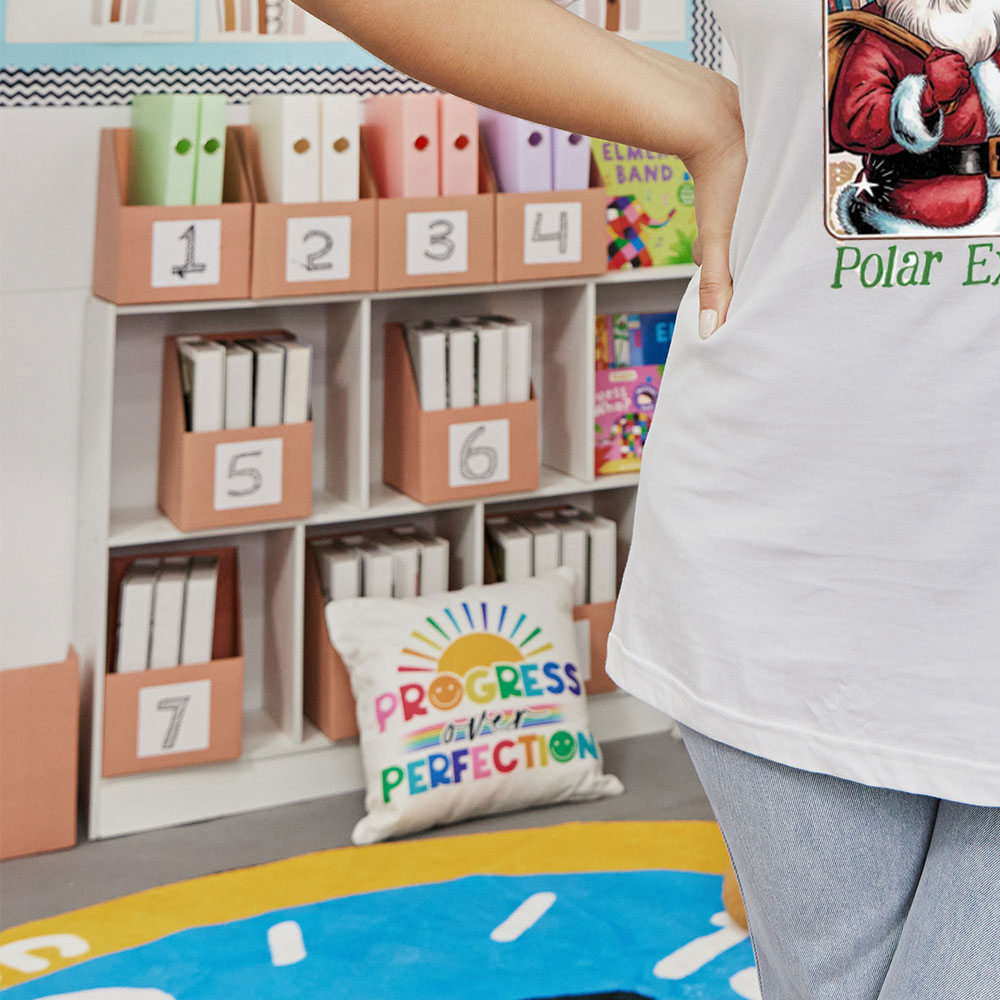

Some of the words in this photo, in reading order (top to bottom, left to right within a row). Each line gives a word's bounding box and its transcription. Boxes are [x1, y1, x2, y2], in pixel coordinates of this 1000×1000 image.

[616, 164, 673, 184] BAND
[172, 223, 207, 279] 1
[301, 229, 335, 272] 2
[424, 218, 456, 262] 3
[530, 210, 569, 254] 4
[830, 246, 943, 290] Polar
[227, 450, 264, 498] 5
[459, 425, 499, 481] 6
[157, 694, 191, 750] 7
[442, 708, 530, 744] over
